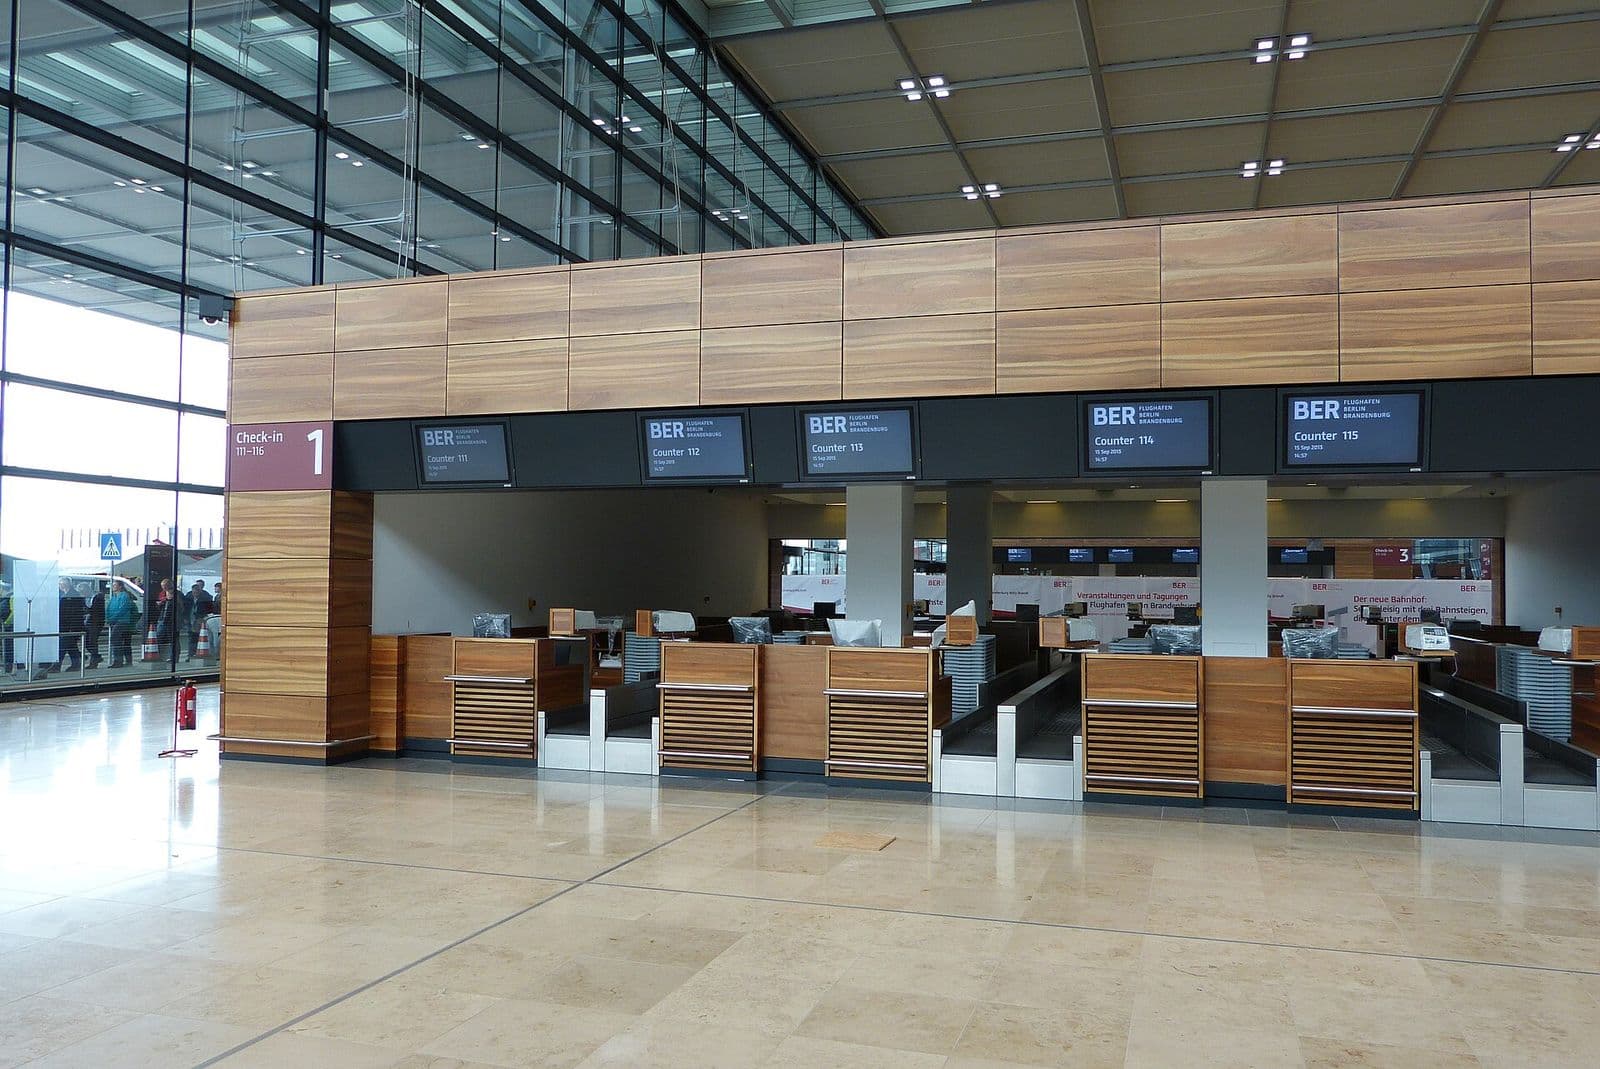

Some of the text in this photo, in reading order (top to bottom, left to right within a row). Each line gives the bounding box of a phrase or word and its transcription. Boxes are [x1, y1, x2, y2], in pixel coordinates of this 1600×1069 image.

[1094, 406, 1136, 426] BER
[1294, 400, 1340, 420] BER
[650, 422, 684, 438] BER
[810, 416, 847, 434] BER
[236, 430, 283, 443] Check-in
[424, 430, 454, 446] BER
[1095, 436, 1154, 446] Counter 114
[1294, 431, 1358, 441] Counter 115
[307, 429, 323, 475] 1
[653, 449, 684, 457] Counter
[812, 444, 846, 452] Counter
[1400, 549, 1408, 561] 3
[1077, 592, 1135, 600] Veranstaltungen
[1436, 606, 1488, 615] Bahnsteigen,
